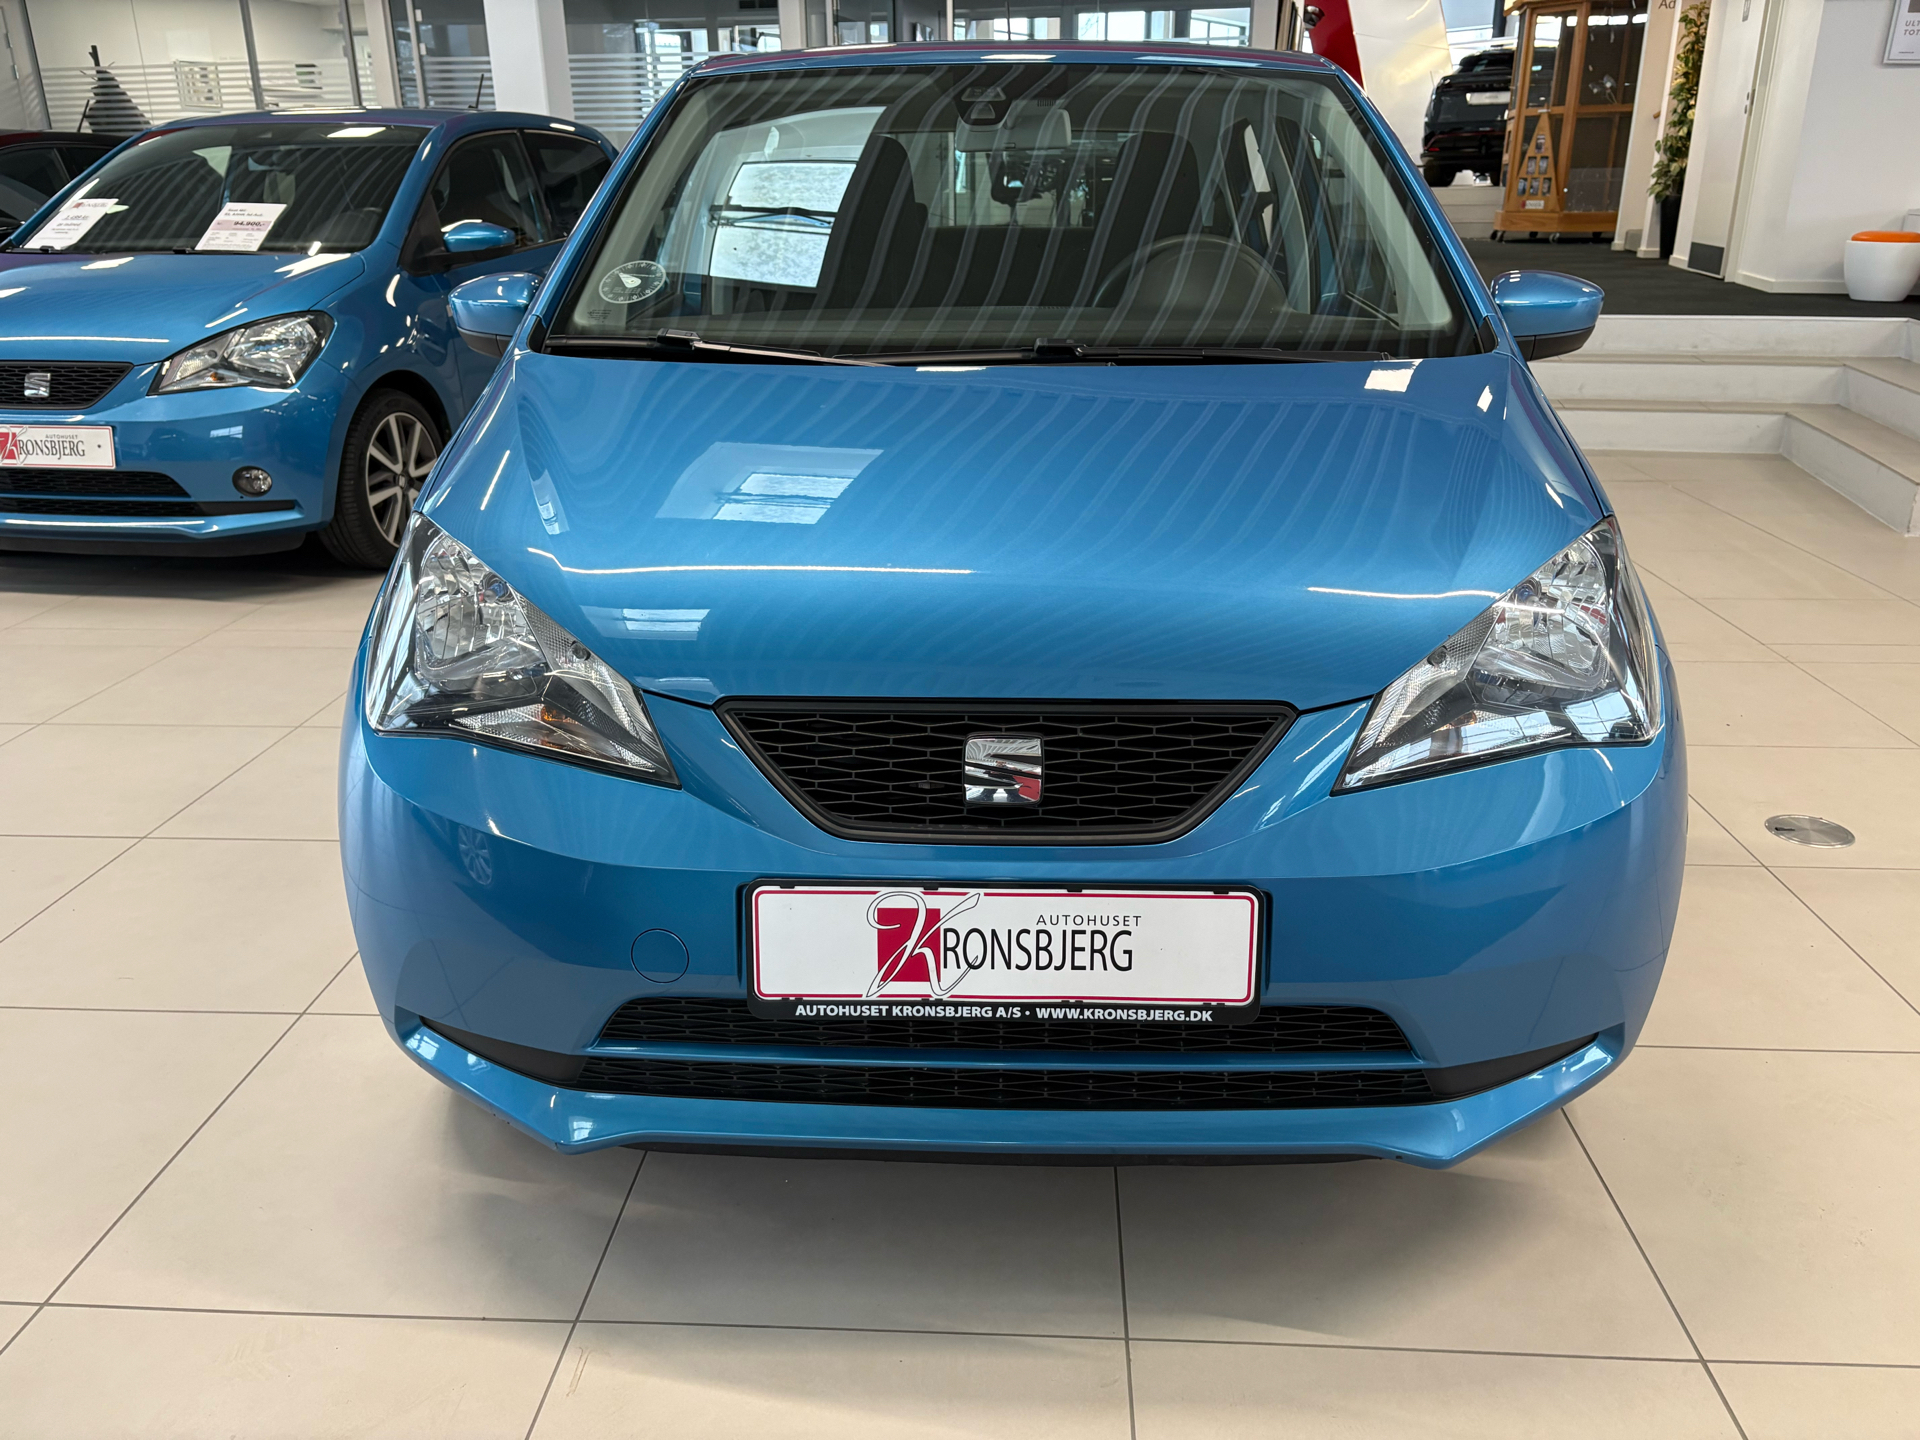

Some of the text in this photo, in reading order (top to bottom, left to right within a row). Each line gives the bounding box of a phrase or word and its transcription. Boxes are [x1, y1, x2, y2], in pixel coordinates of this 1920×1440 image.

[1036, 914, 1142, 927] AUTOHUSET
[866, 891, 1133, 997] KRONSBJERG
[795, 1005, 1213, 1022] AUTOHUSET KRONSBJERG A/S WWW.KRONSBJERG.DK
